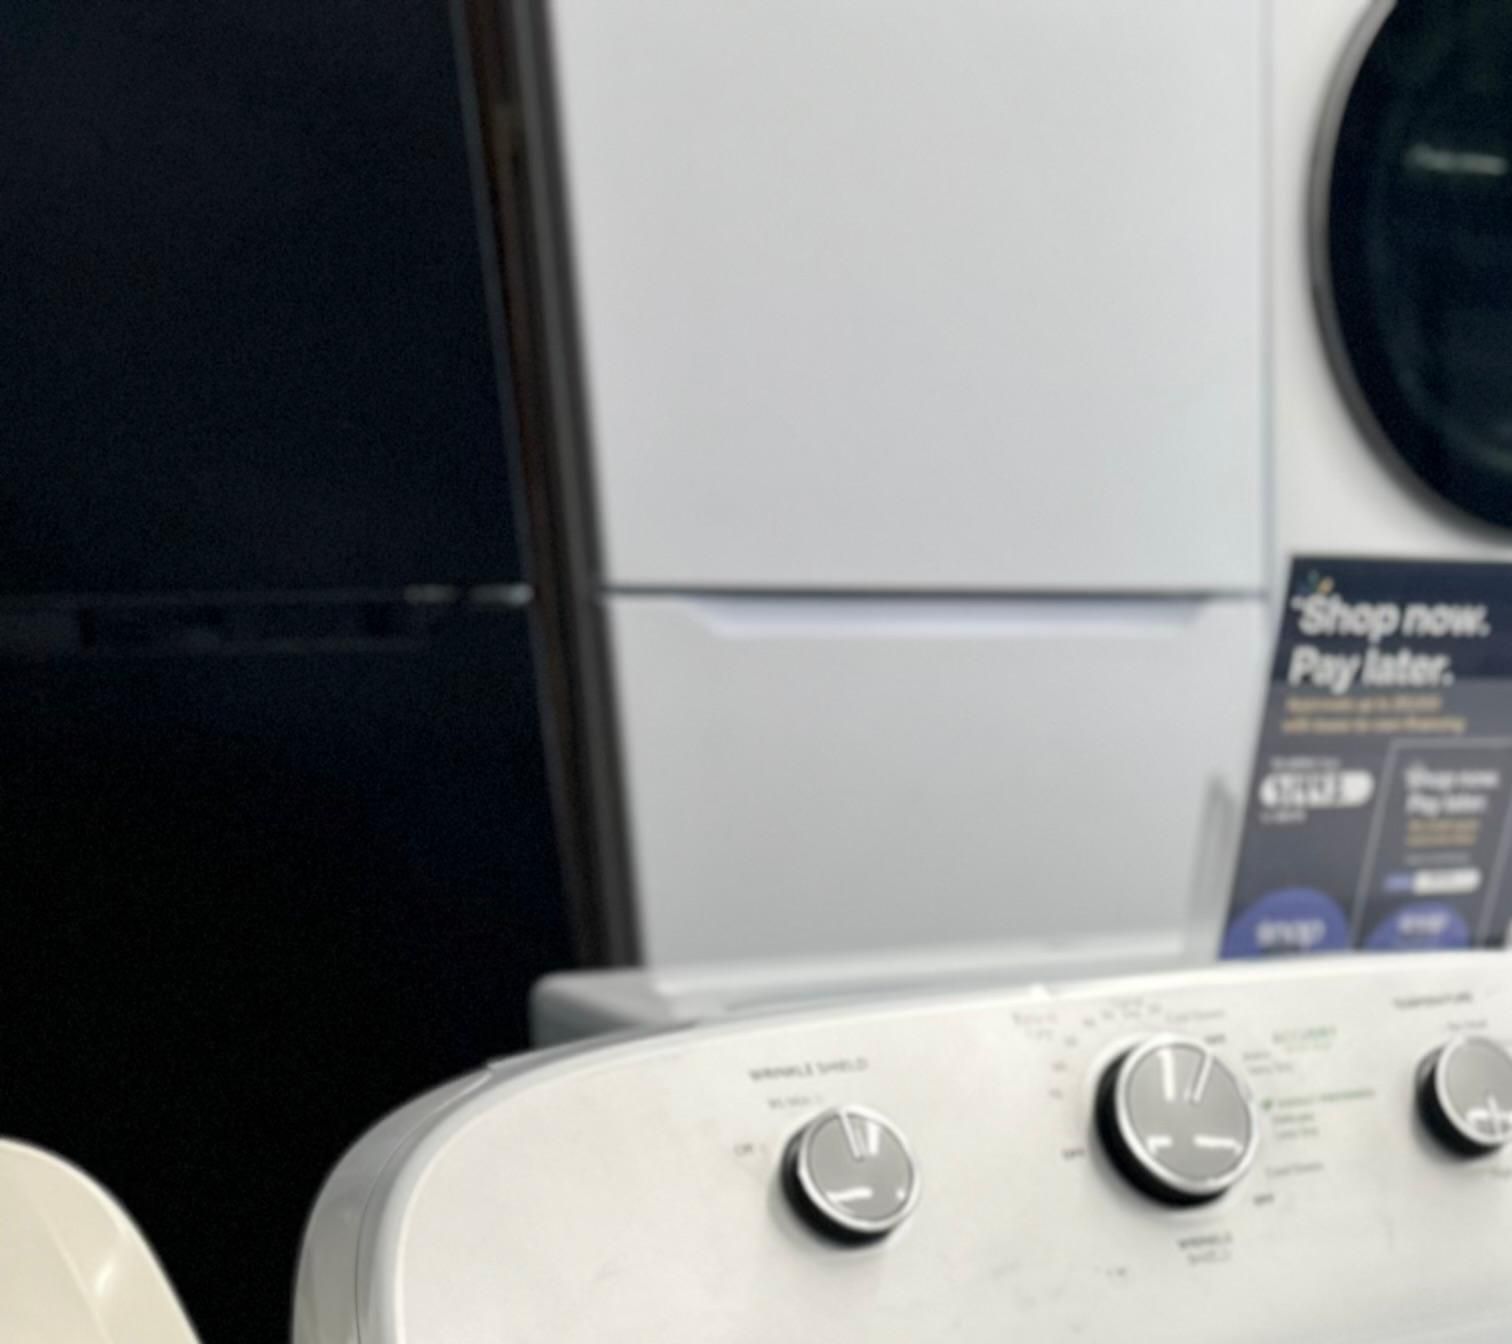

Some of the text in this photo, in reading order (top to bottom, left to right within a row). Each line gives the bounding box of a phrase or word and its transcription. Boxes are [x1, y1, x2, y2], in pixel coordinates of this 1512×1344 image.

[1298, 594, 1491, 643] Shop now.
[1287, 645, 1455, 695] Pay later.
[749, 1061, 813, 1083] WRINKLE
